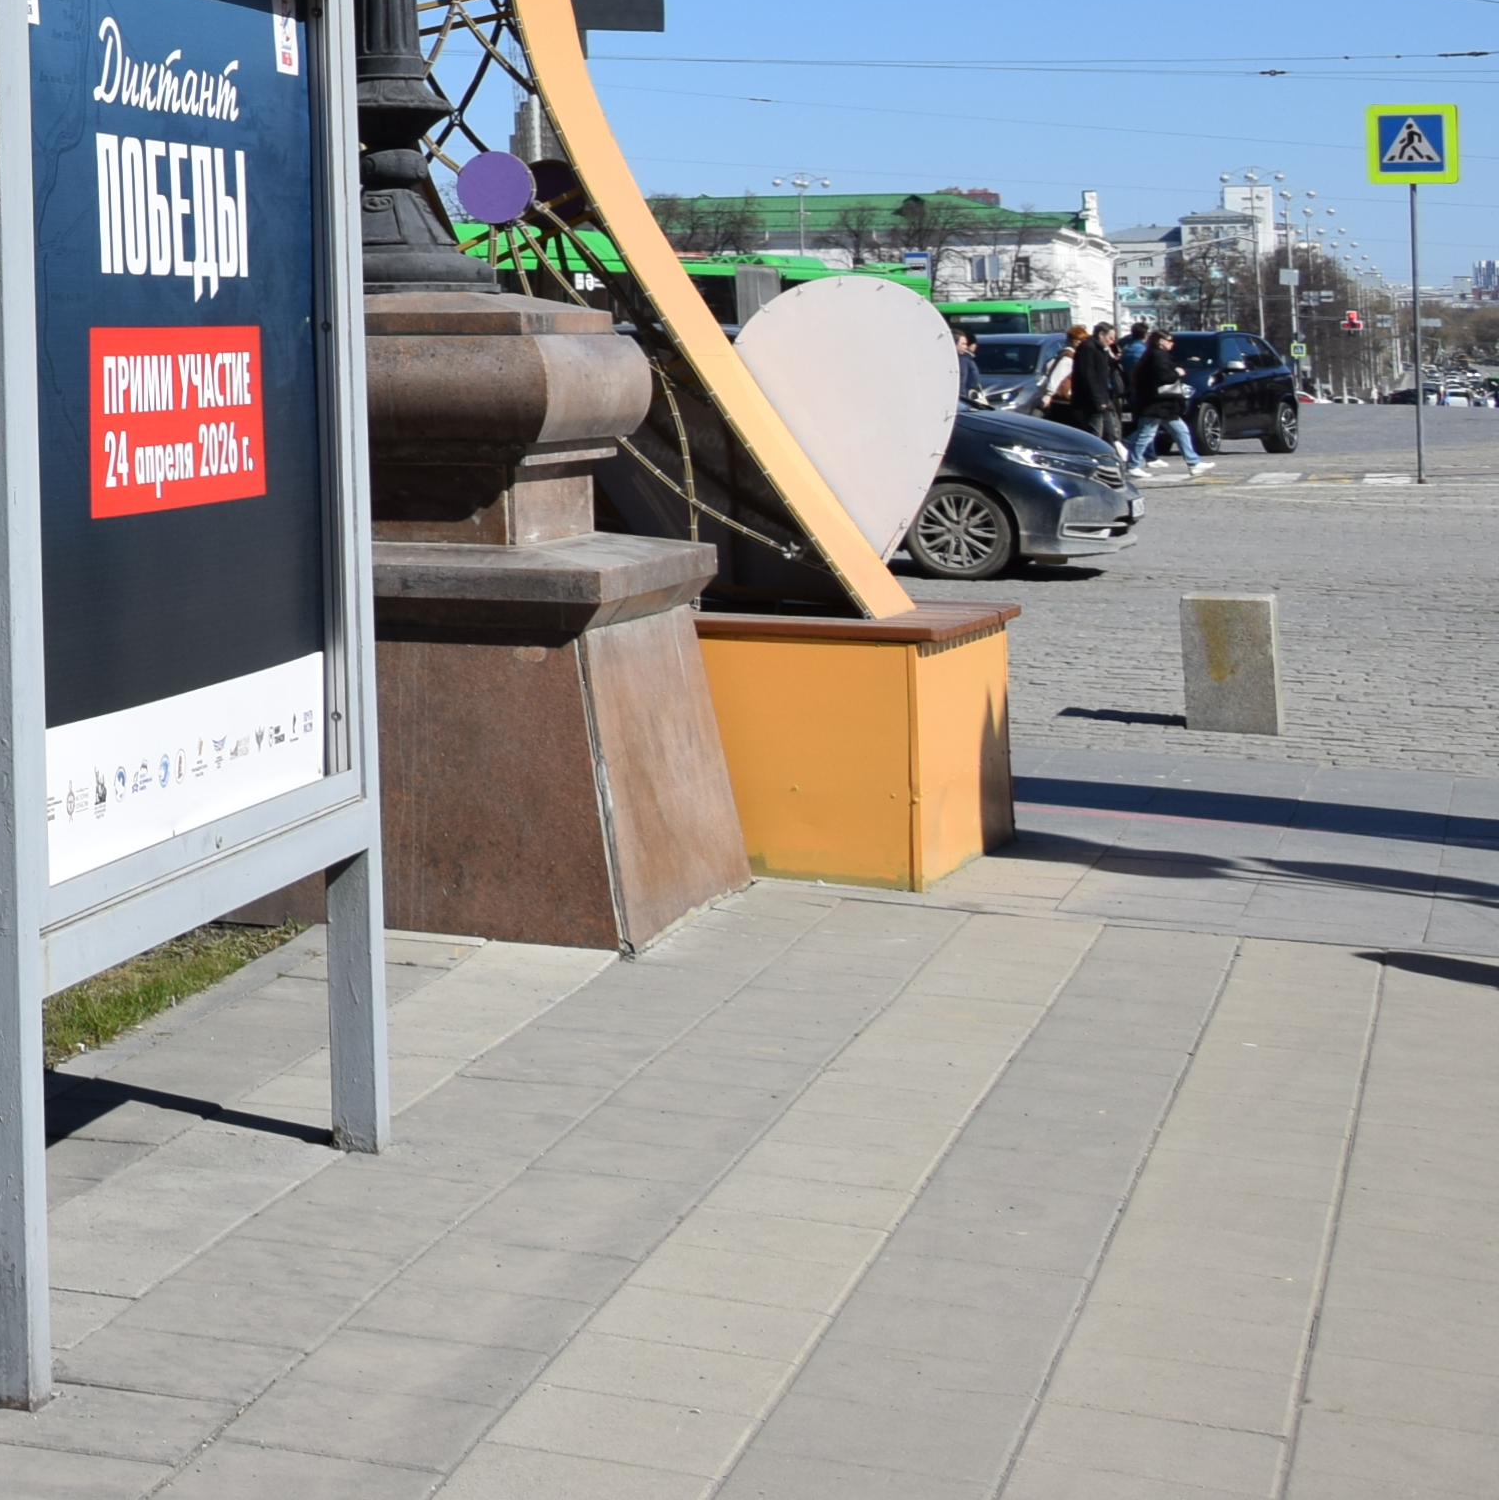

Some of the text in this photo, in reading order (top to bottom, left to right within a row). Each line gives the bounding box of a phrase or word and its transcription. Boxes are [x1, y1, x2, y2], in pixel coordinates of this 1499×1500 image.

[93, 16, 239, 122] Диктант
[96, 132, 248, 303] ПОБЕДЫ
[103, 352, 252, 415] ПРИМИ УЧАСТИЕ
[104, 422, 254, 499] 24 апреля 2026 г.
